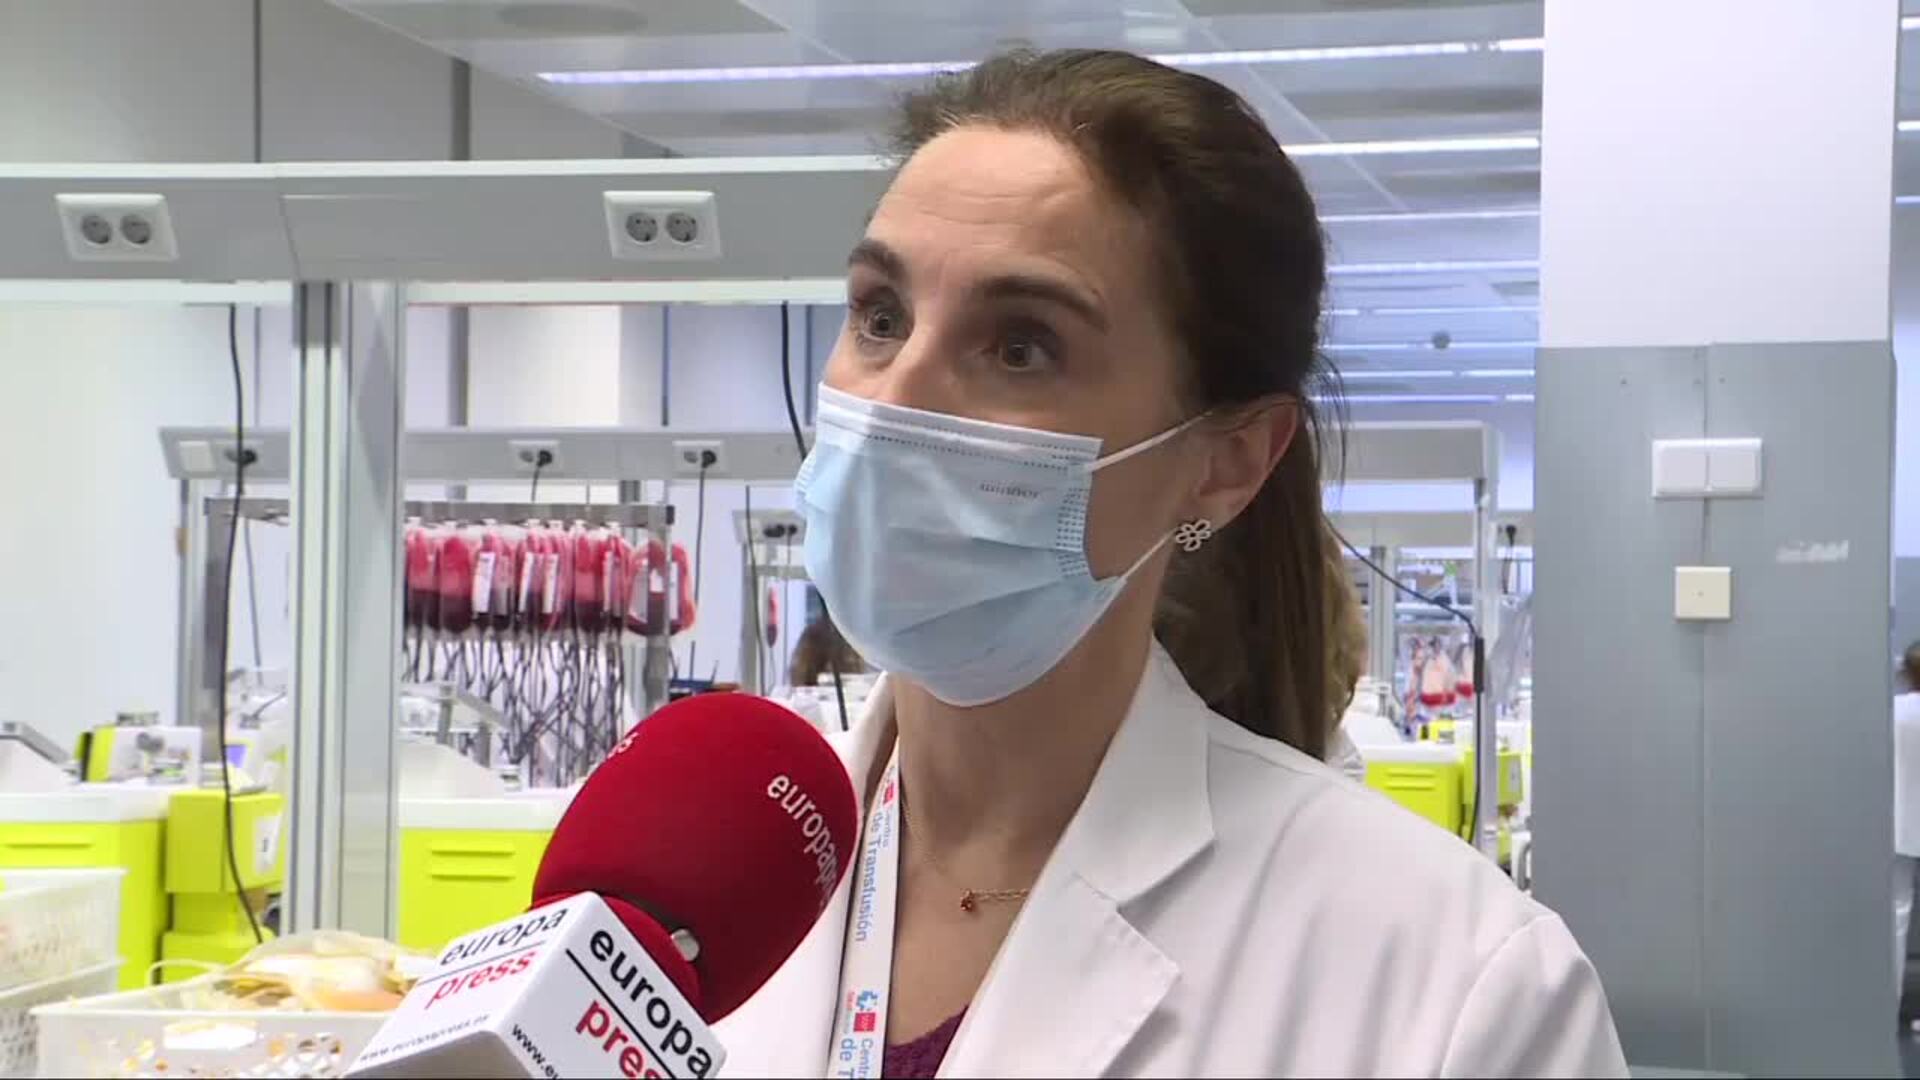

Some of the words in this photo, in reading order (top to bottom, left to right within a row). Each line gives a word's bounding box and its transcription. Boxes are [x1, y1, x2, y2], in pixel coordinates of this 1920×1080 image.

[855, 835, 882, 942] Transfusión
[440, 908, 568, 966] europa
[423, 950, 537, 1010] press
[589, 928, 713, 1078] europa
[840, 1038, 857, 1062] de
